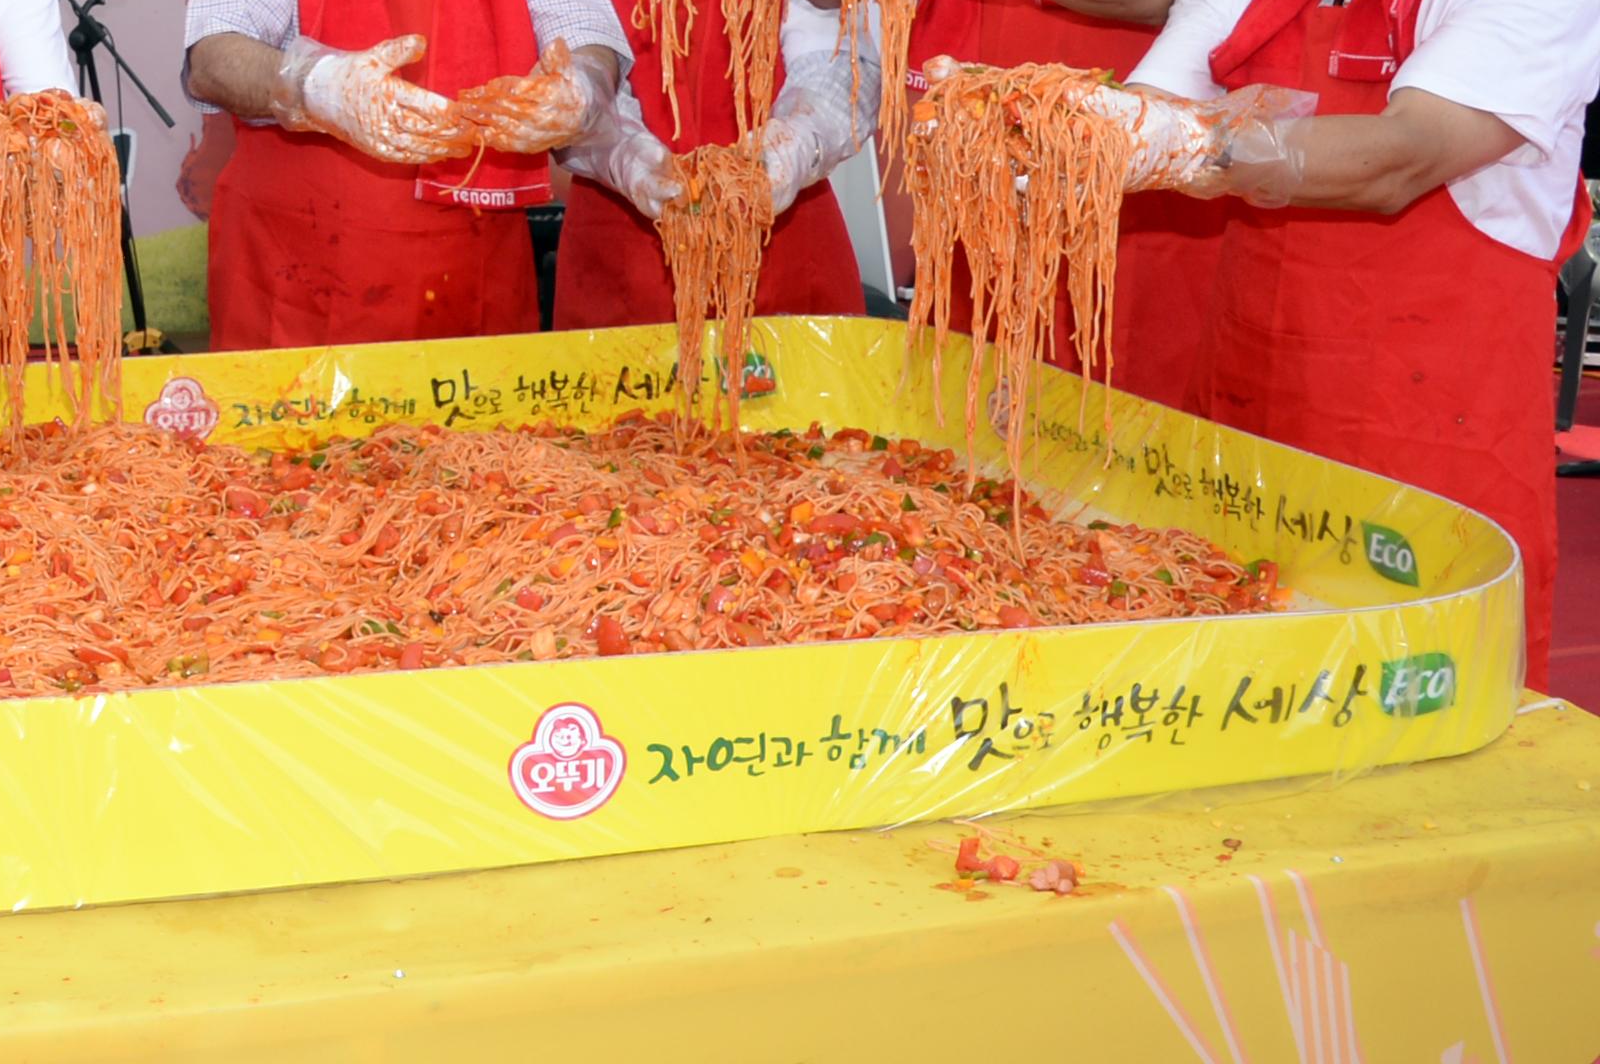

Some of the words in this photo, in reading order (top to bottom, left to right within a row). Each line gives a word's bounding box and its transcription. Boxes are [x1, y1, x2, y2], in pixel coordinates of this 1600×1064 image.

[452, 189, 515, 206] renoma
[431, 368, 503, 427] 맛으로
[513, 370, 599, 416] 행복한
[1143, 442, 1194, 500] 맛으로
[1198, 467, 1266, 533] 행복한
[1275, 494, 1358, 565] 세상
[646, 731, 812, 784] 자연과
[820, 713, 926, 771] 함께
[950, 681, 1056, 772] 맛으로
[1073, 681, 1204, 751] 행복한
[1219, 664, 1372, 732] 세상
[528, 757, 605, 795] 오뚜기
